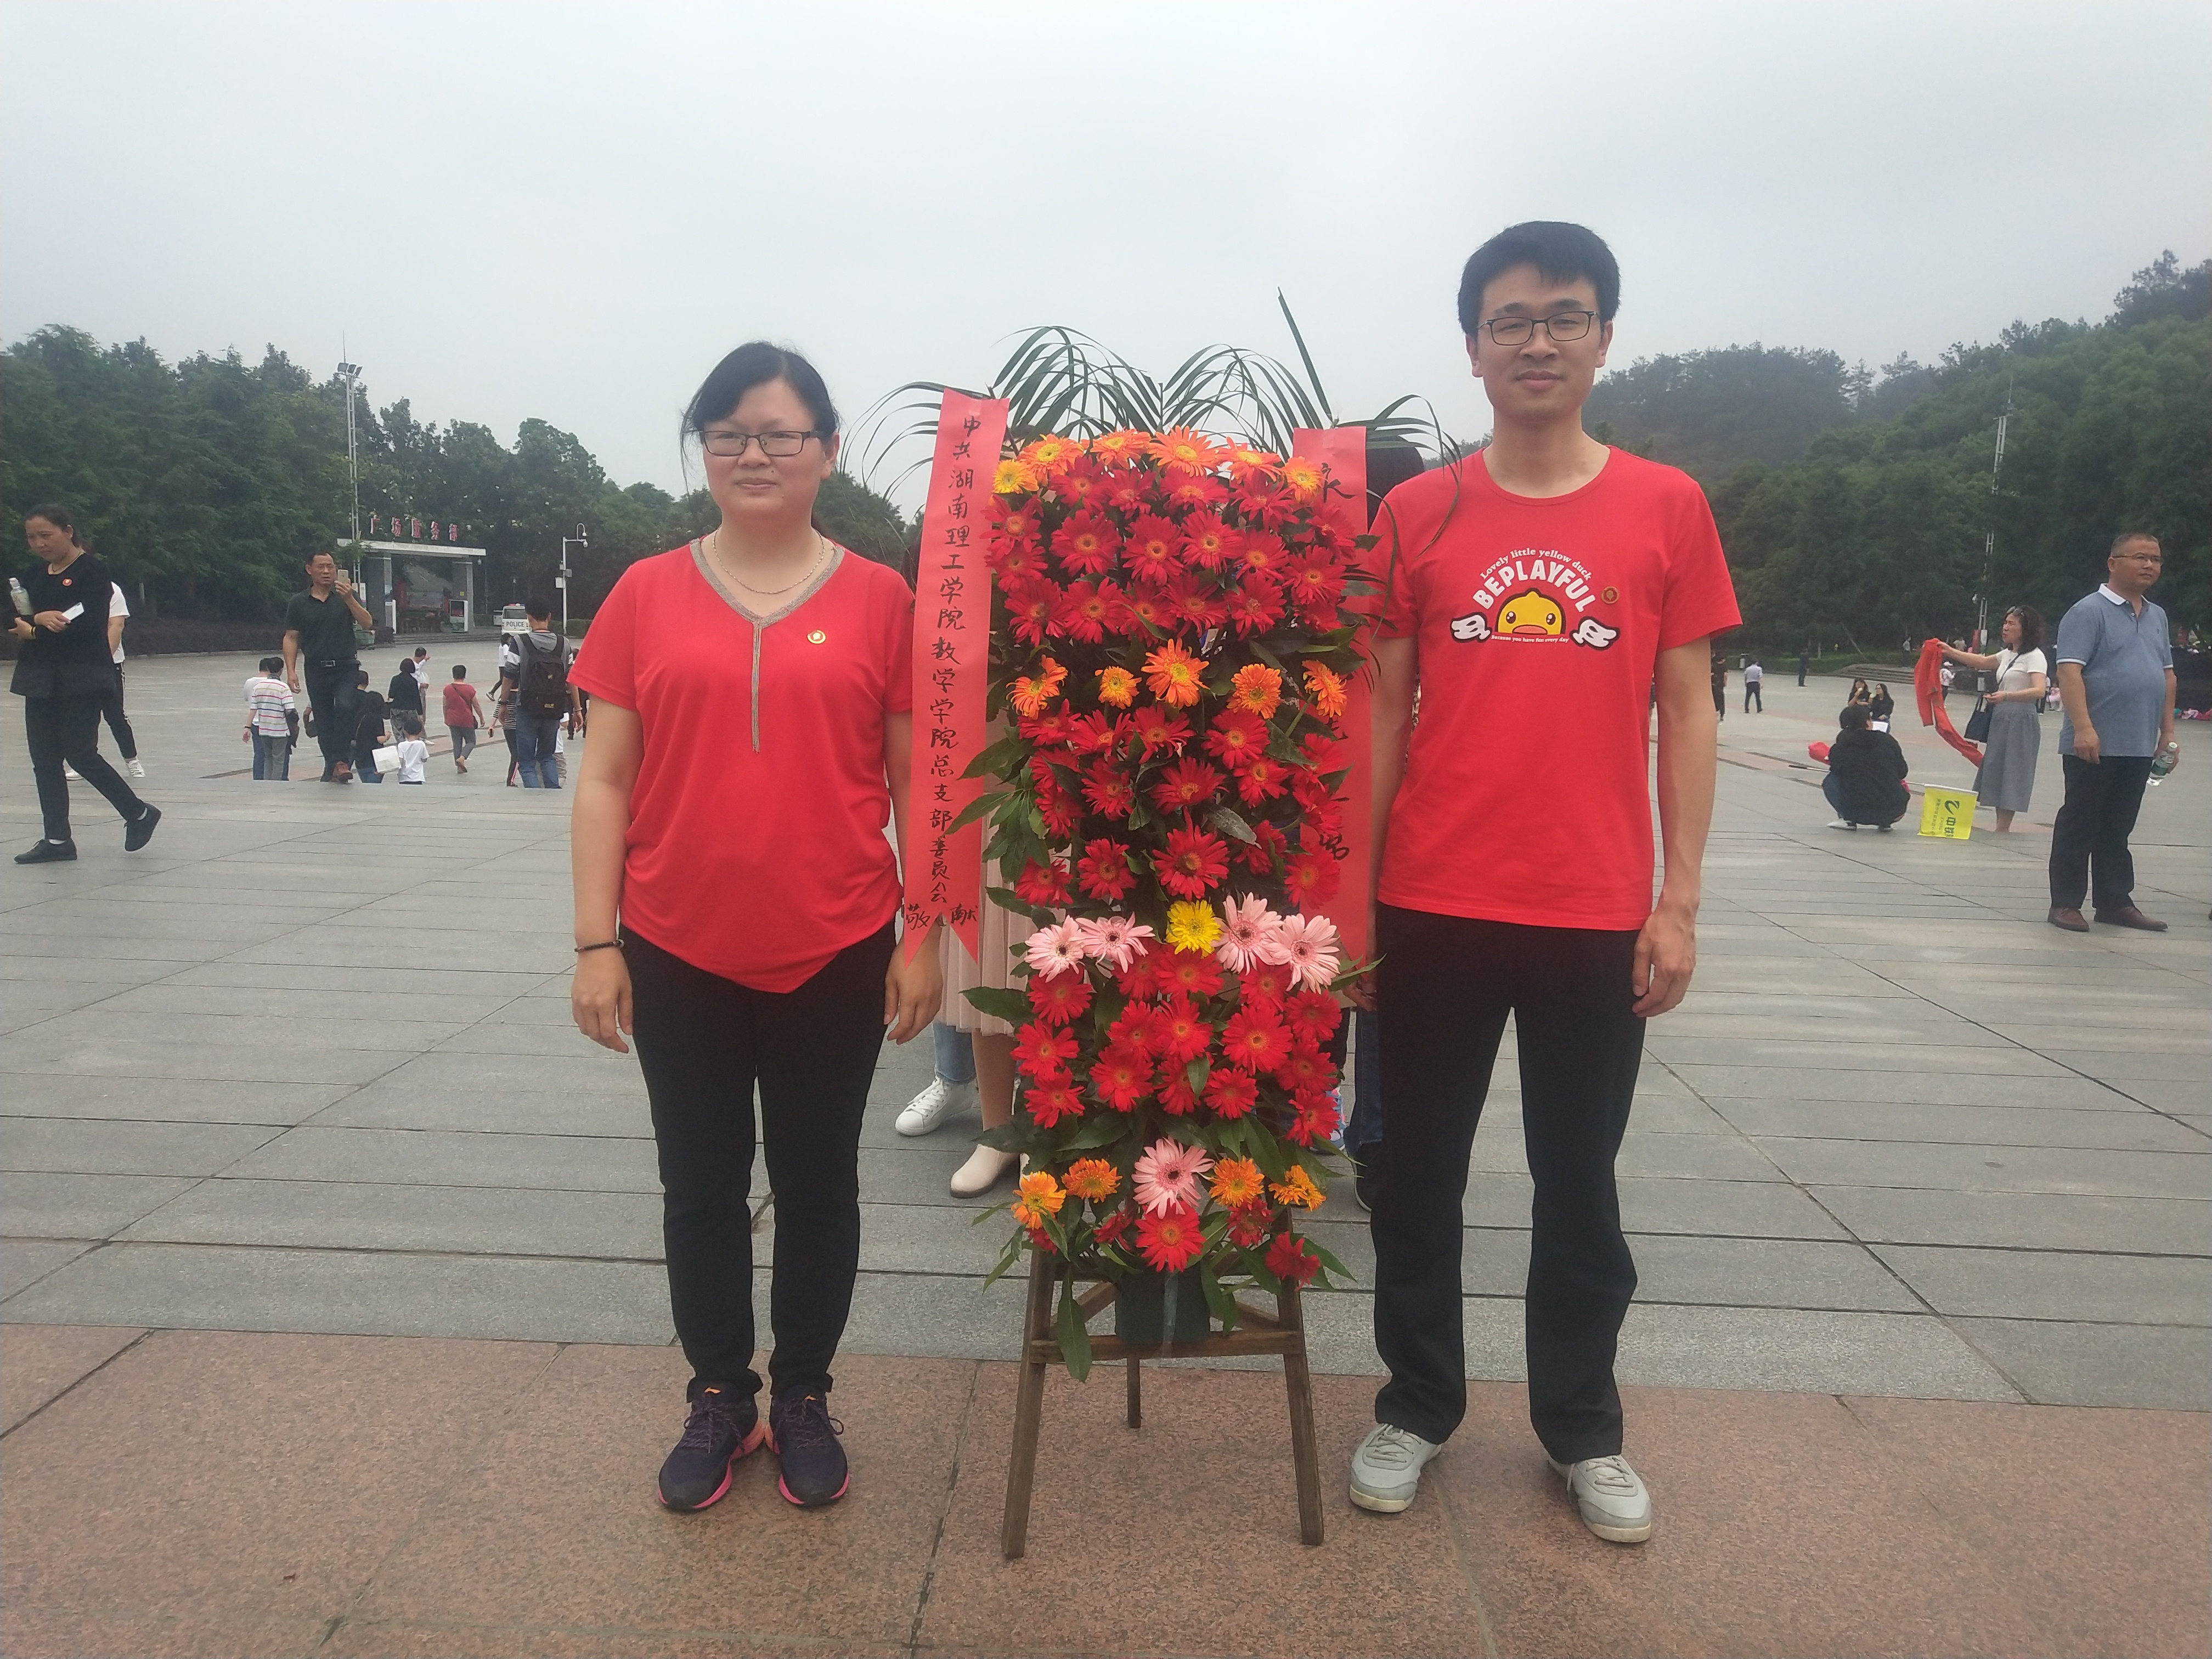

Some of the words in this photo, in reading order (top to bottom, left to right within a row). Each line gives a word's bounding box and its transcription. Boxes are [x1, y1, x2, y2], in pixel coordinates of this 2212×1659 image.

[370, 517, 458, 541] 广场服务部
[1480, 554, 1509, 580] Lovely
[1510, 548, 1536, 560] little
[1538, 549, 1572, 563] yellow
[1572, 560, 1592, 581] duck
